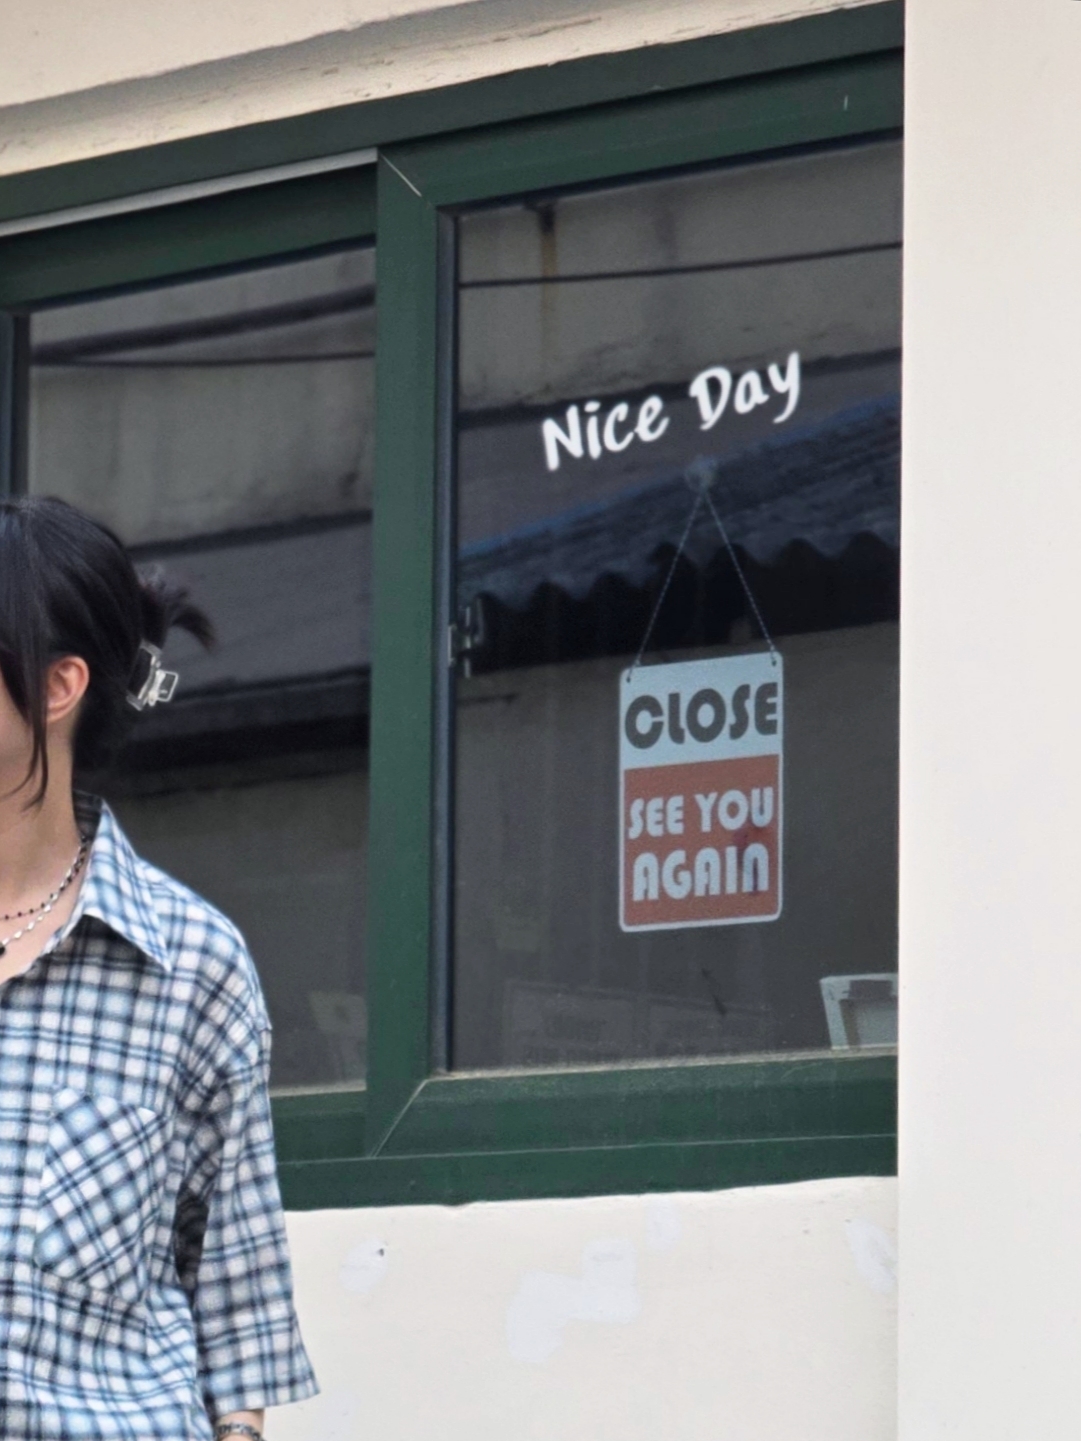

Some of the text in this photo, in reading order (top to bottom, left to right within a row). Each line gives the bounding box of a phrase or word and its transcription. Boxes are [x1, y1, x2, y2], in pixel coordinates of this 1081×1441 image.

[542, 351, 800, 471] Nice Day
[625, 682, 778, 749] CLOSE
[628, 787, 774, 840] SEE YOU
[633, 842, 769, 901] AGAIN
